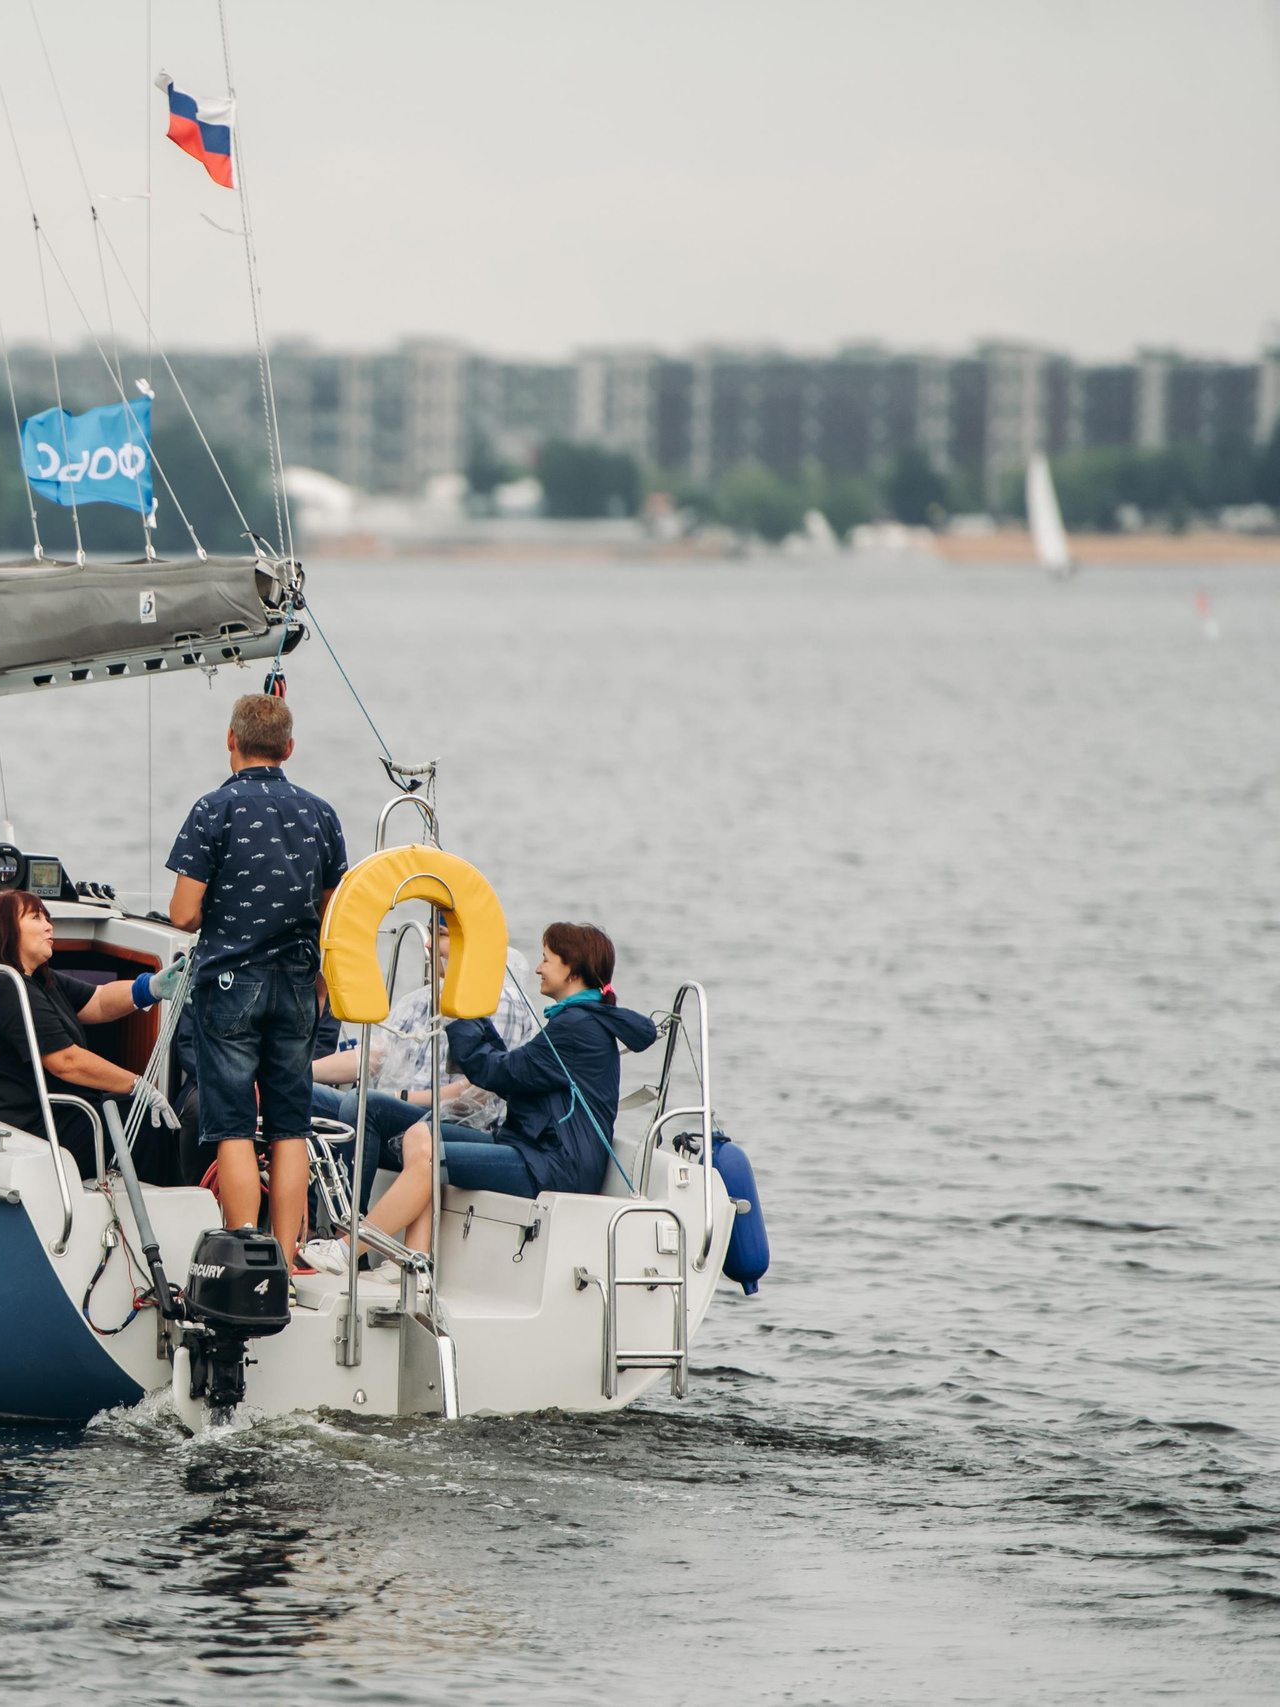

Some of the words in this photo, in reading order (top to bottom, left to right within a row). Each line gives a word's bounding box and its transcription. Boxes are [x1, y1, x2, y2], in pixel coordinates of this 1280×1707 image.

[36, 442, 146, 482] ФОРС
[189, 1262, 226, 1279] ERCURY
[253, 1278, 270, 1295] 4
